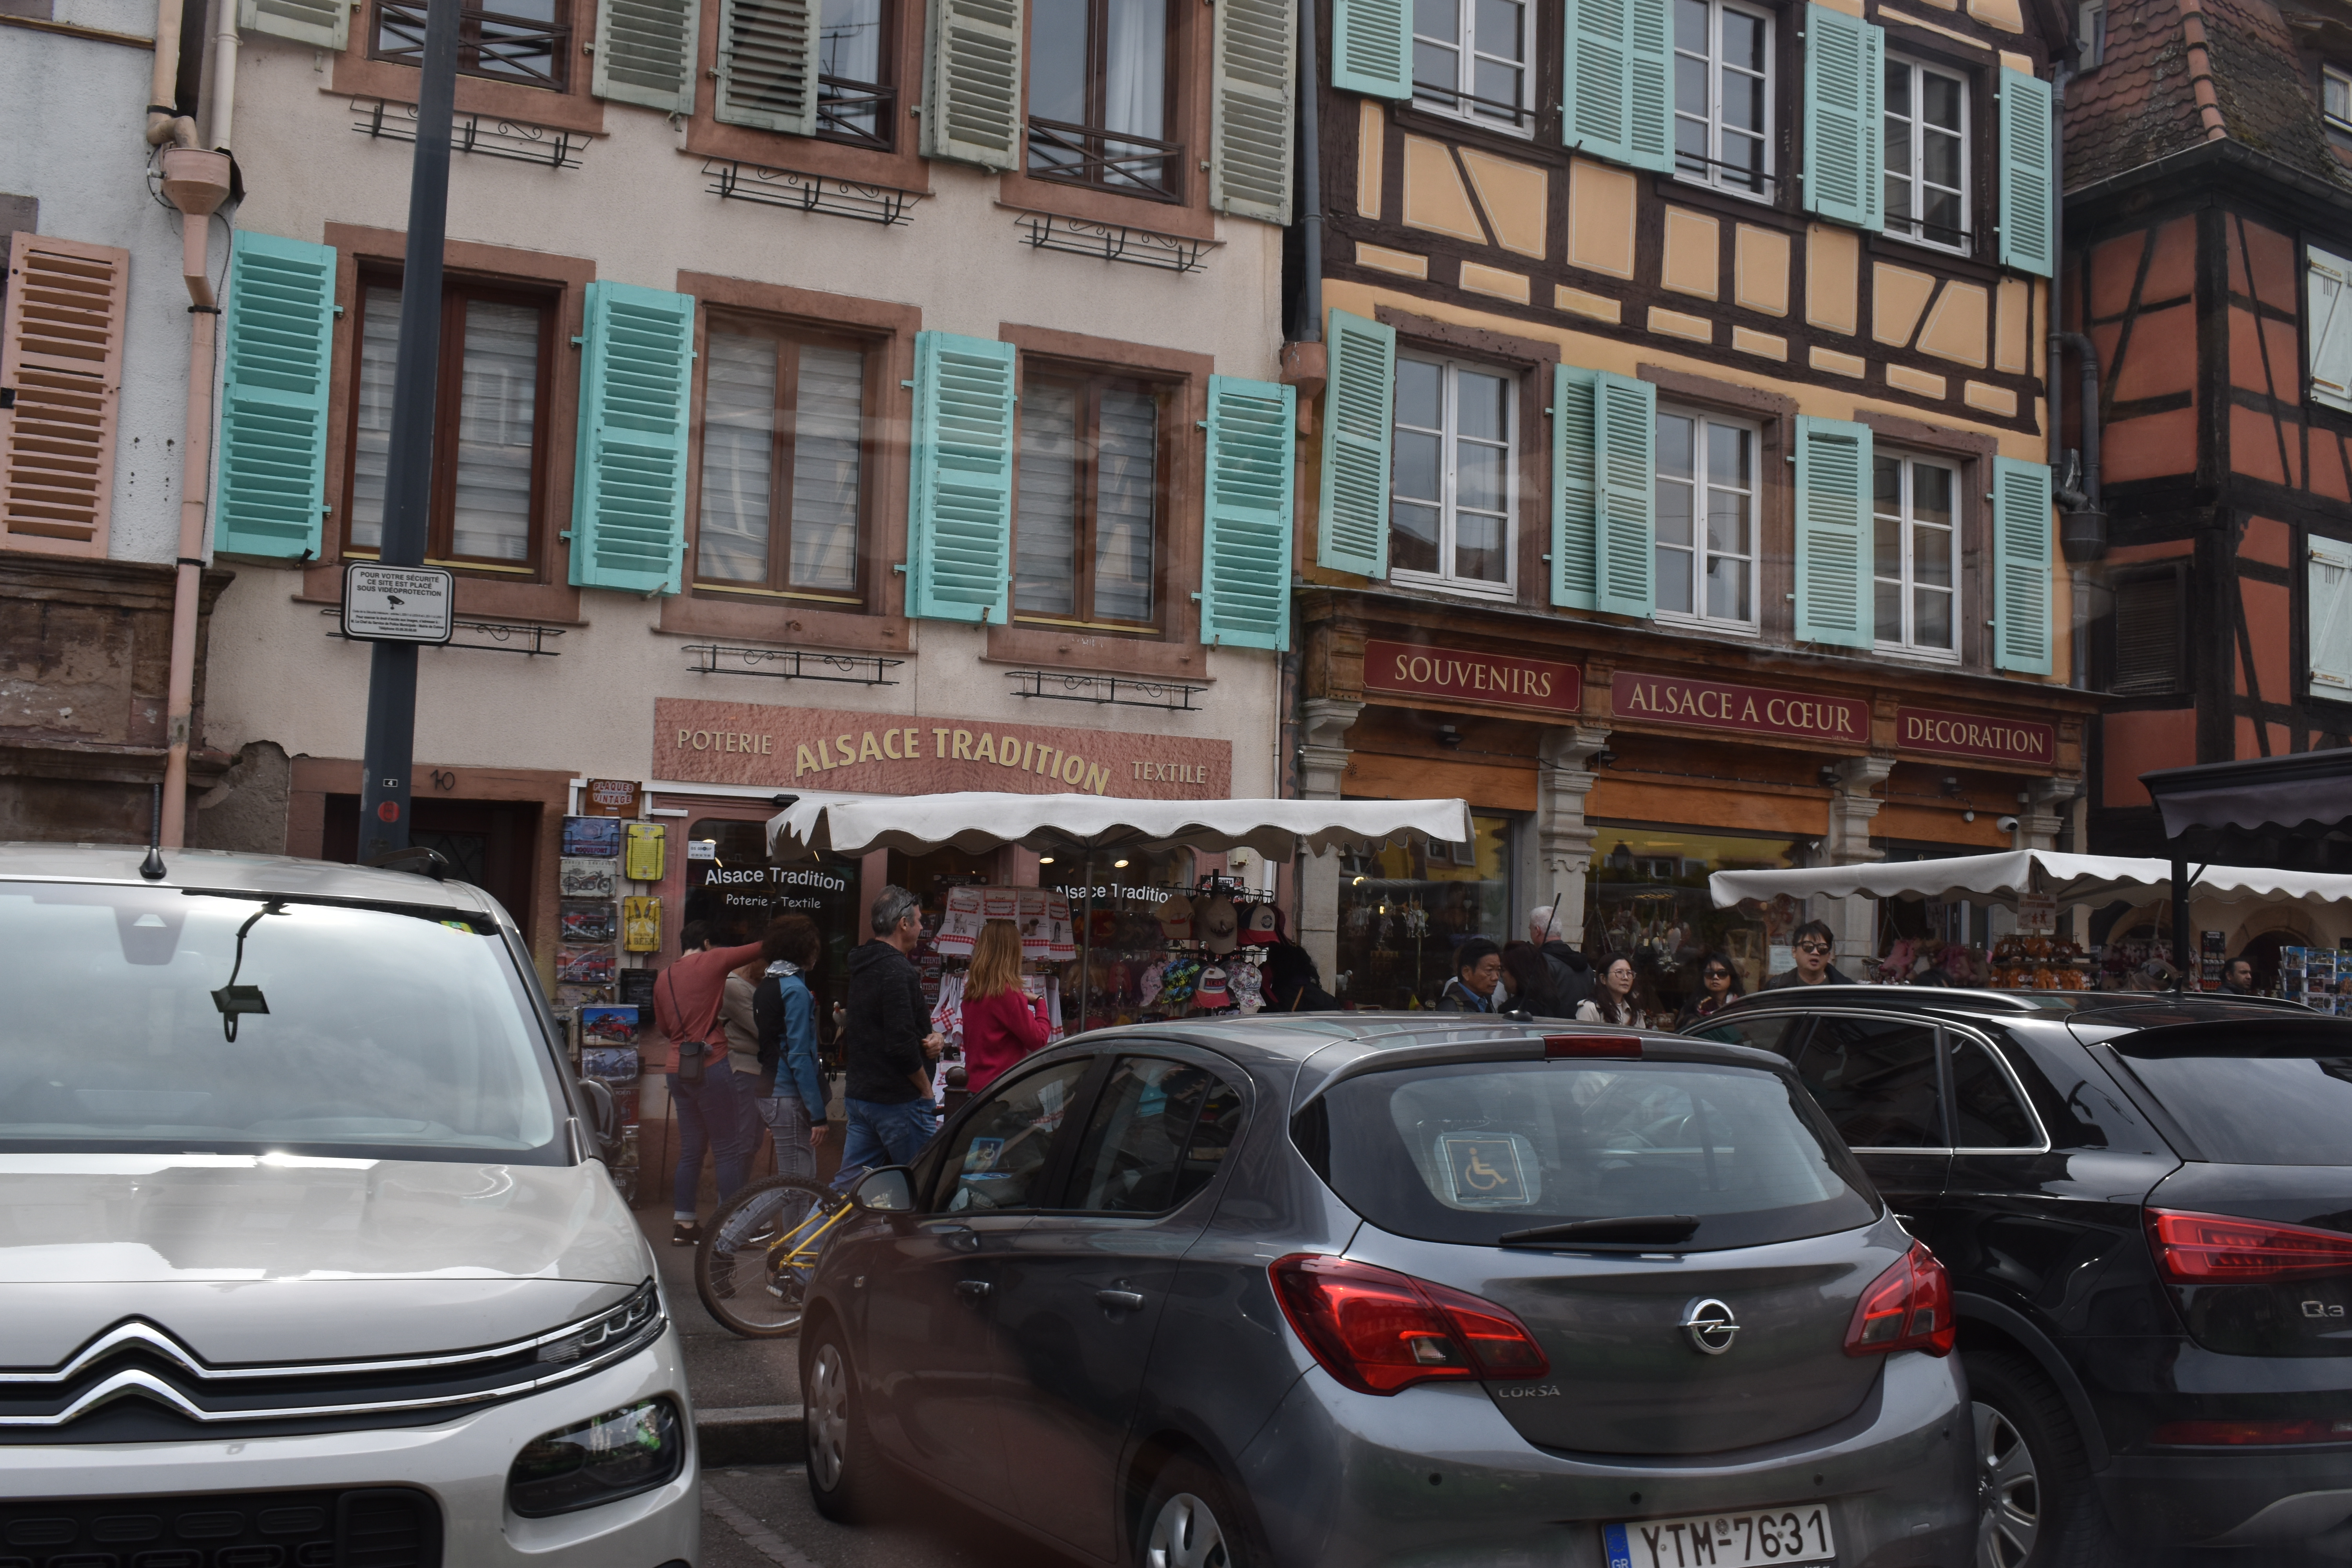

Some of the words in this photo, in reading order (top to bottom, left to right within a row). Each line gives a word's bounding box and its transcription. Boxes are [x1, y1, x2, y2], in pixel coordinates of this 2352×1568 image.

[406, 574, 439, 583] SÉCURITÉ
[378, 586, 441, 597] VIDÉOPROTECTION
[1395, 654, 1551, 697] SOUVENIRS
[1627, 682, 1733, 720] ALSACE
[1739, 695, 1760, 722] A
[1767, 699, 1855, 733] CŒUR
[677, 729, 772, 755] POTERIE
[1907, 717, 2043, 754] DECORATION
[796, 728, 920, 777] ALSACE
[932, 728, 1111, 796] TRADITION
[1131, 761, 1206, 784] TEXTILE
[430, 769, 455, 791] 10
[594, 782, 633, 792] PLAQUES
[594, 794, 631, 804] VINTAGE
[705, 868, 764, 886] Alsace
[769, 867, 845, 891] Tradition
[726, 894, 768, 906] Poterie
[780, 897, 821, 909] Textile
[1111, 883, 1172, 904] Traditio
[2301, 1301, 2345, 1318] Q3
[1498, 1385, 1561, 1398] CORSA
[1640, 1510, 1827, 1568] YTM-7631
[1612, 1558, 1629, 1568] GR
